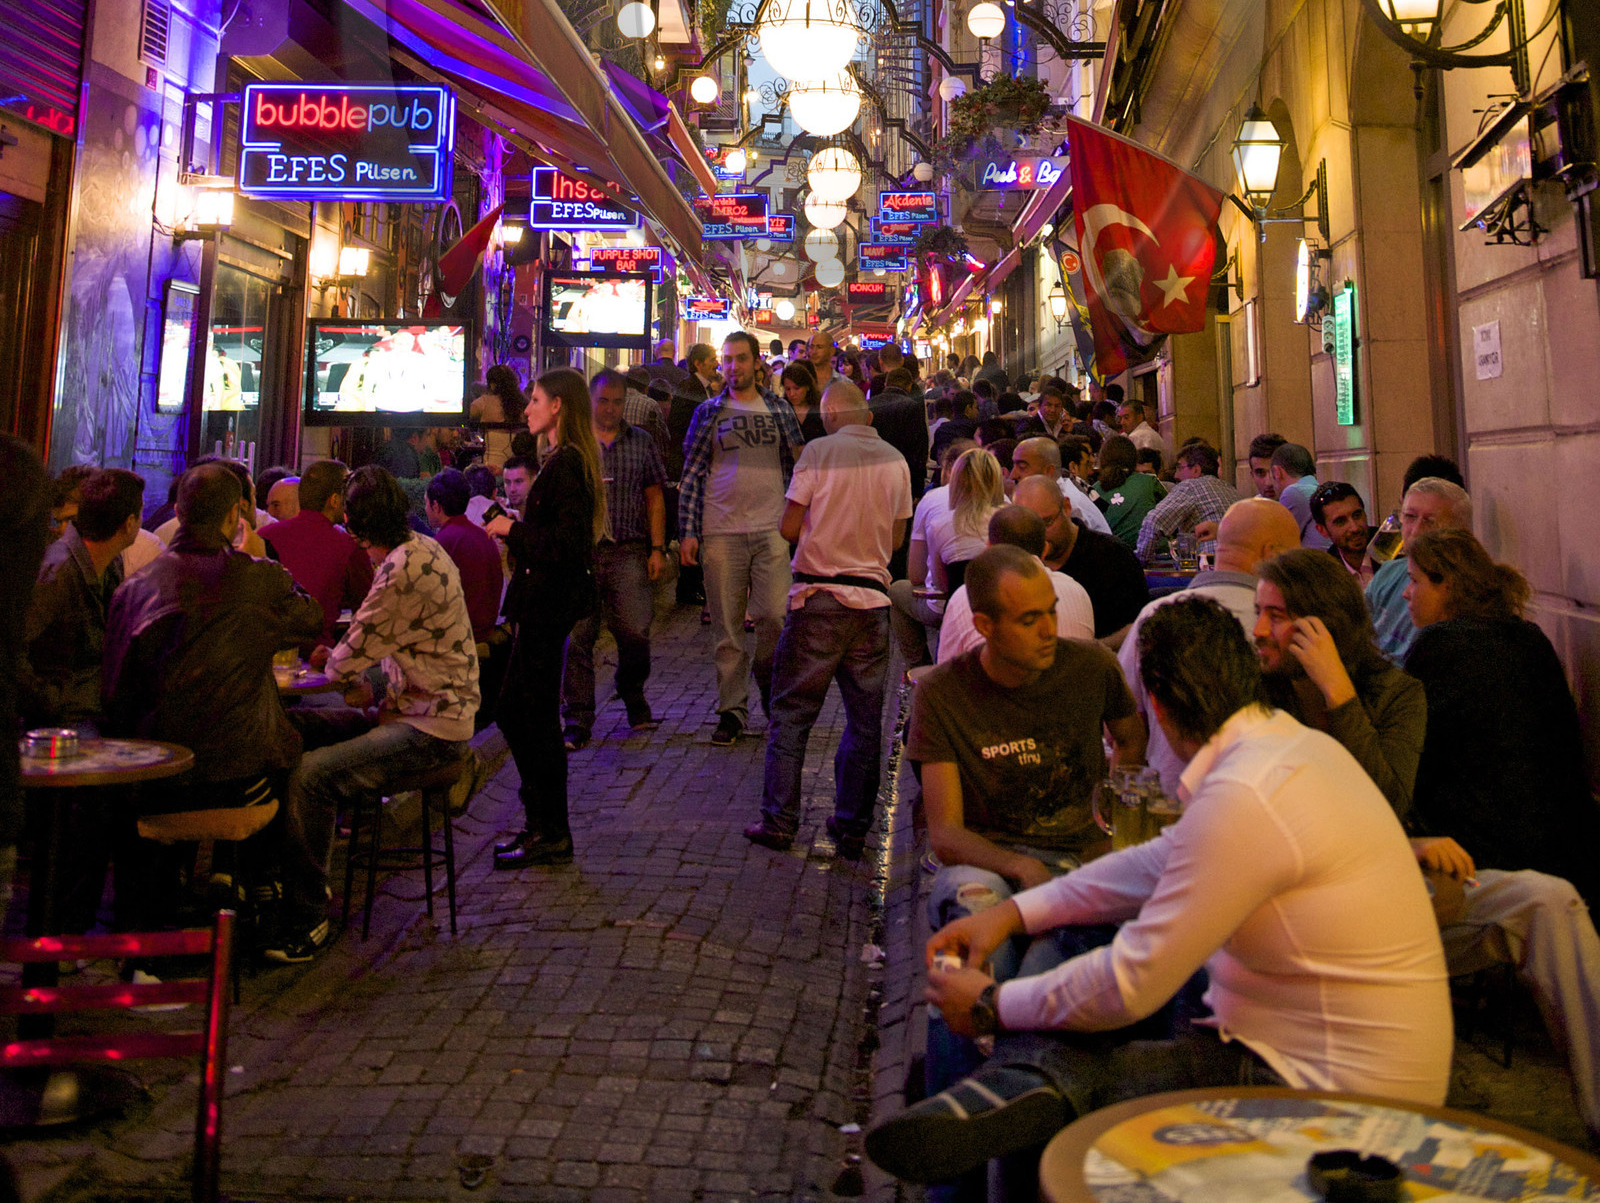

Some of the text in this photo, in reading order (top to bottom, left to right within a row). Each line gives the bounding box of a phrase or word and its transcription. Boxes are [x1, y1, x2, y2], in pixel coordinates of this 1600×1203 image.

[266, 153, 417, 183] EFES Pilsen
[1019, 166, 1032, 184] &
[1036, 161, 1062, 184] Ba
[551, 201, 627, 220] EFES Pilsen
[888, 210, 911, 220] EFES
[703, 223, 733, 235] EFES
[735, 226, 759, 234] Pilsen
[592, 249, 659, 260] PURPLE SHOT
[616, 260, 637, 271] BAR
[981, 737, 1037, 760] SPORTS
